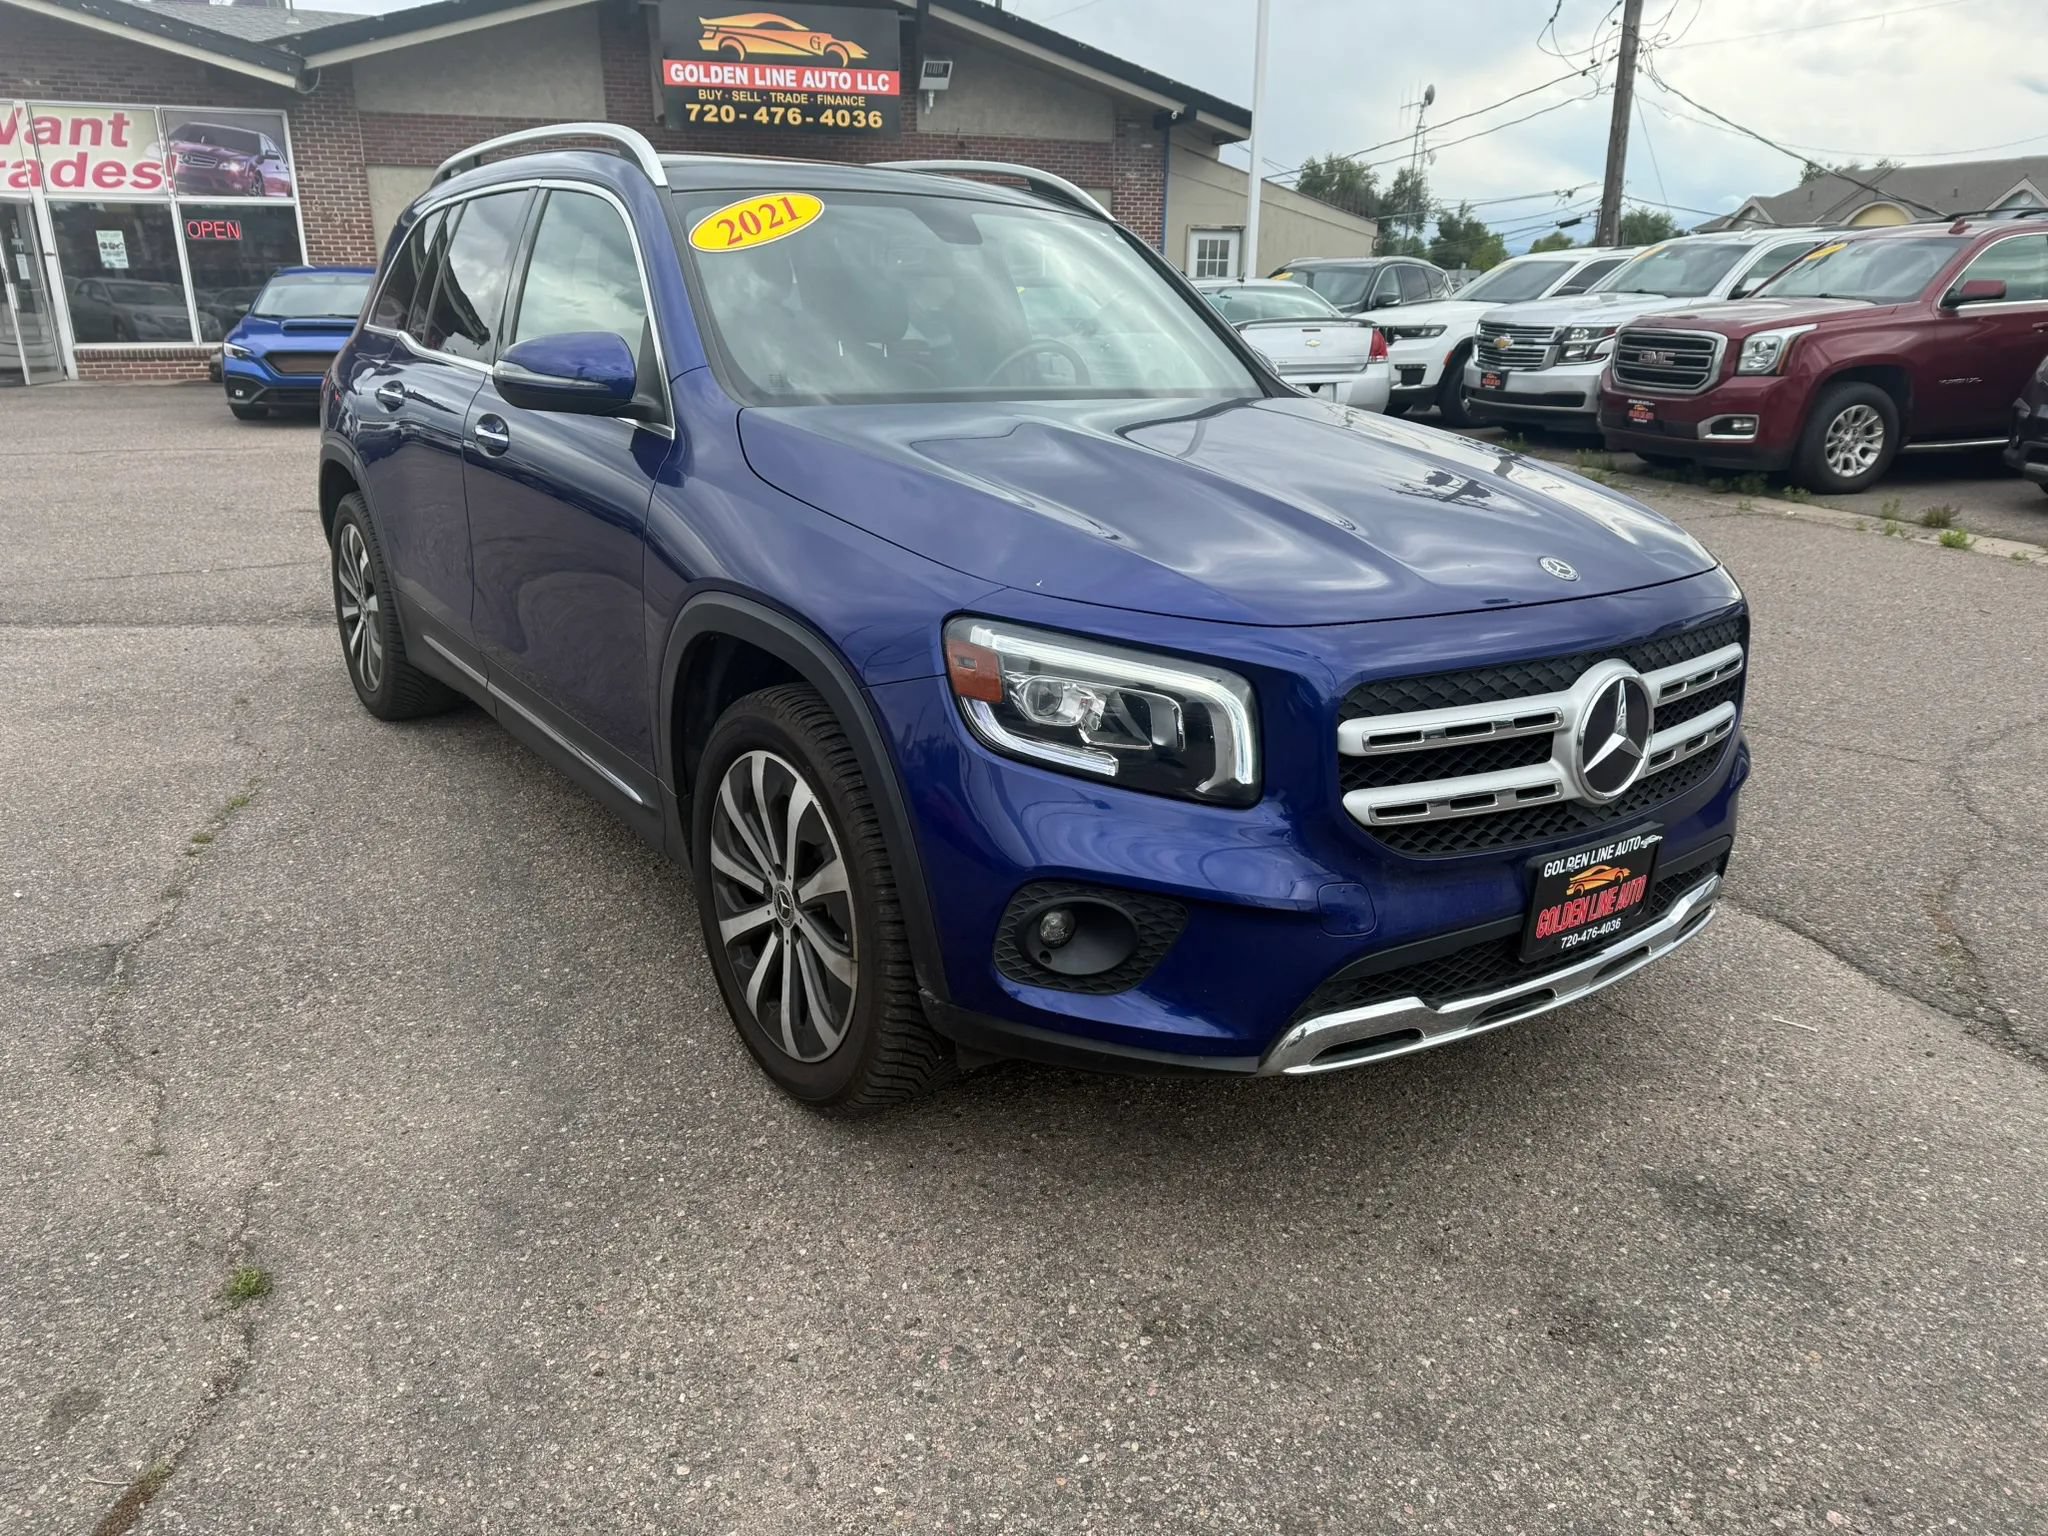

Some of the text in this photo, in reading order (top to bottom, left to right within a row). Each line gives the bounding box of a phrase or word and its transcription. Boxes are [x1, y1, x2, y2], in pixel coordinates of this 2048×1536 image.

[670, 63, 890, 91] GOLDEN LINE AUTO LLC
[698, 89, 866, 107] BUY SELL TRADE FINANCE
[187, 221, 241, 240] OPEN
[716, 196, 802, 246] 2021
[1638, 350, 1676, 366] GMC
[1590, 843, 1617, 864] LINE
[1615, 835, 1642, 856] AUTO
[1535, 874, 1647, 939] GOLDEN LINE AUTO
[1561, 917, 1622, 949] 720-476-4036
